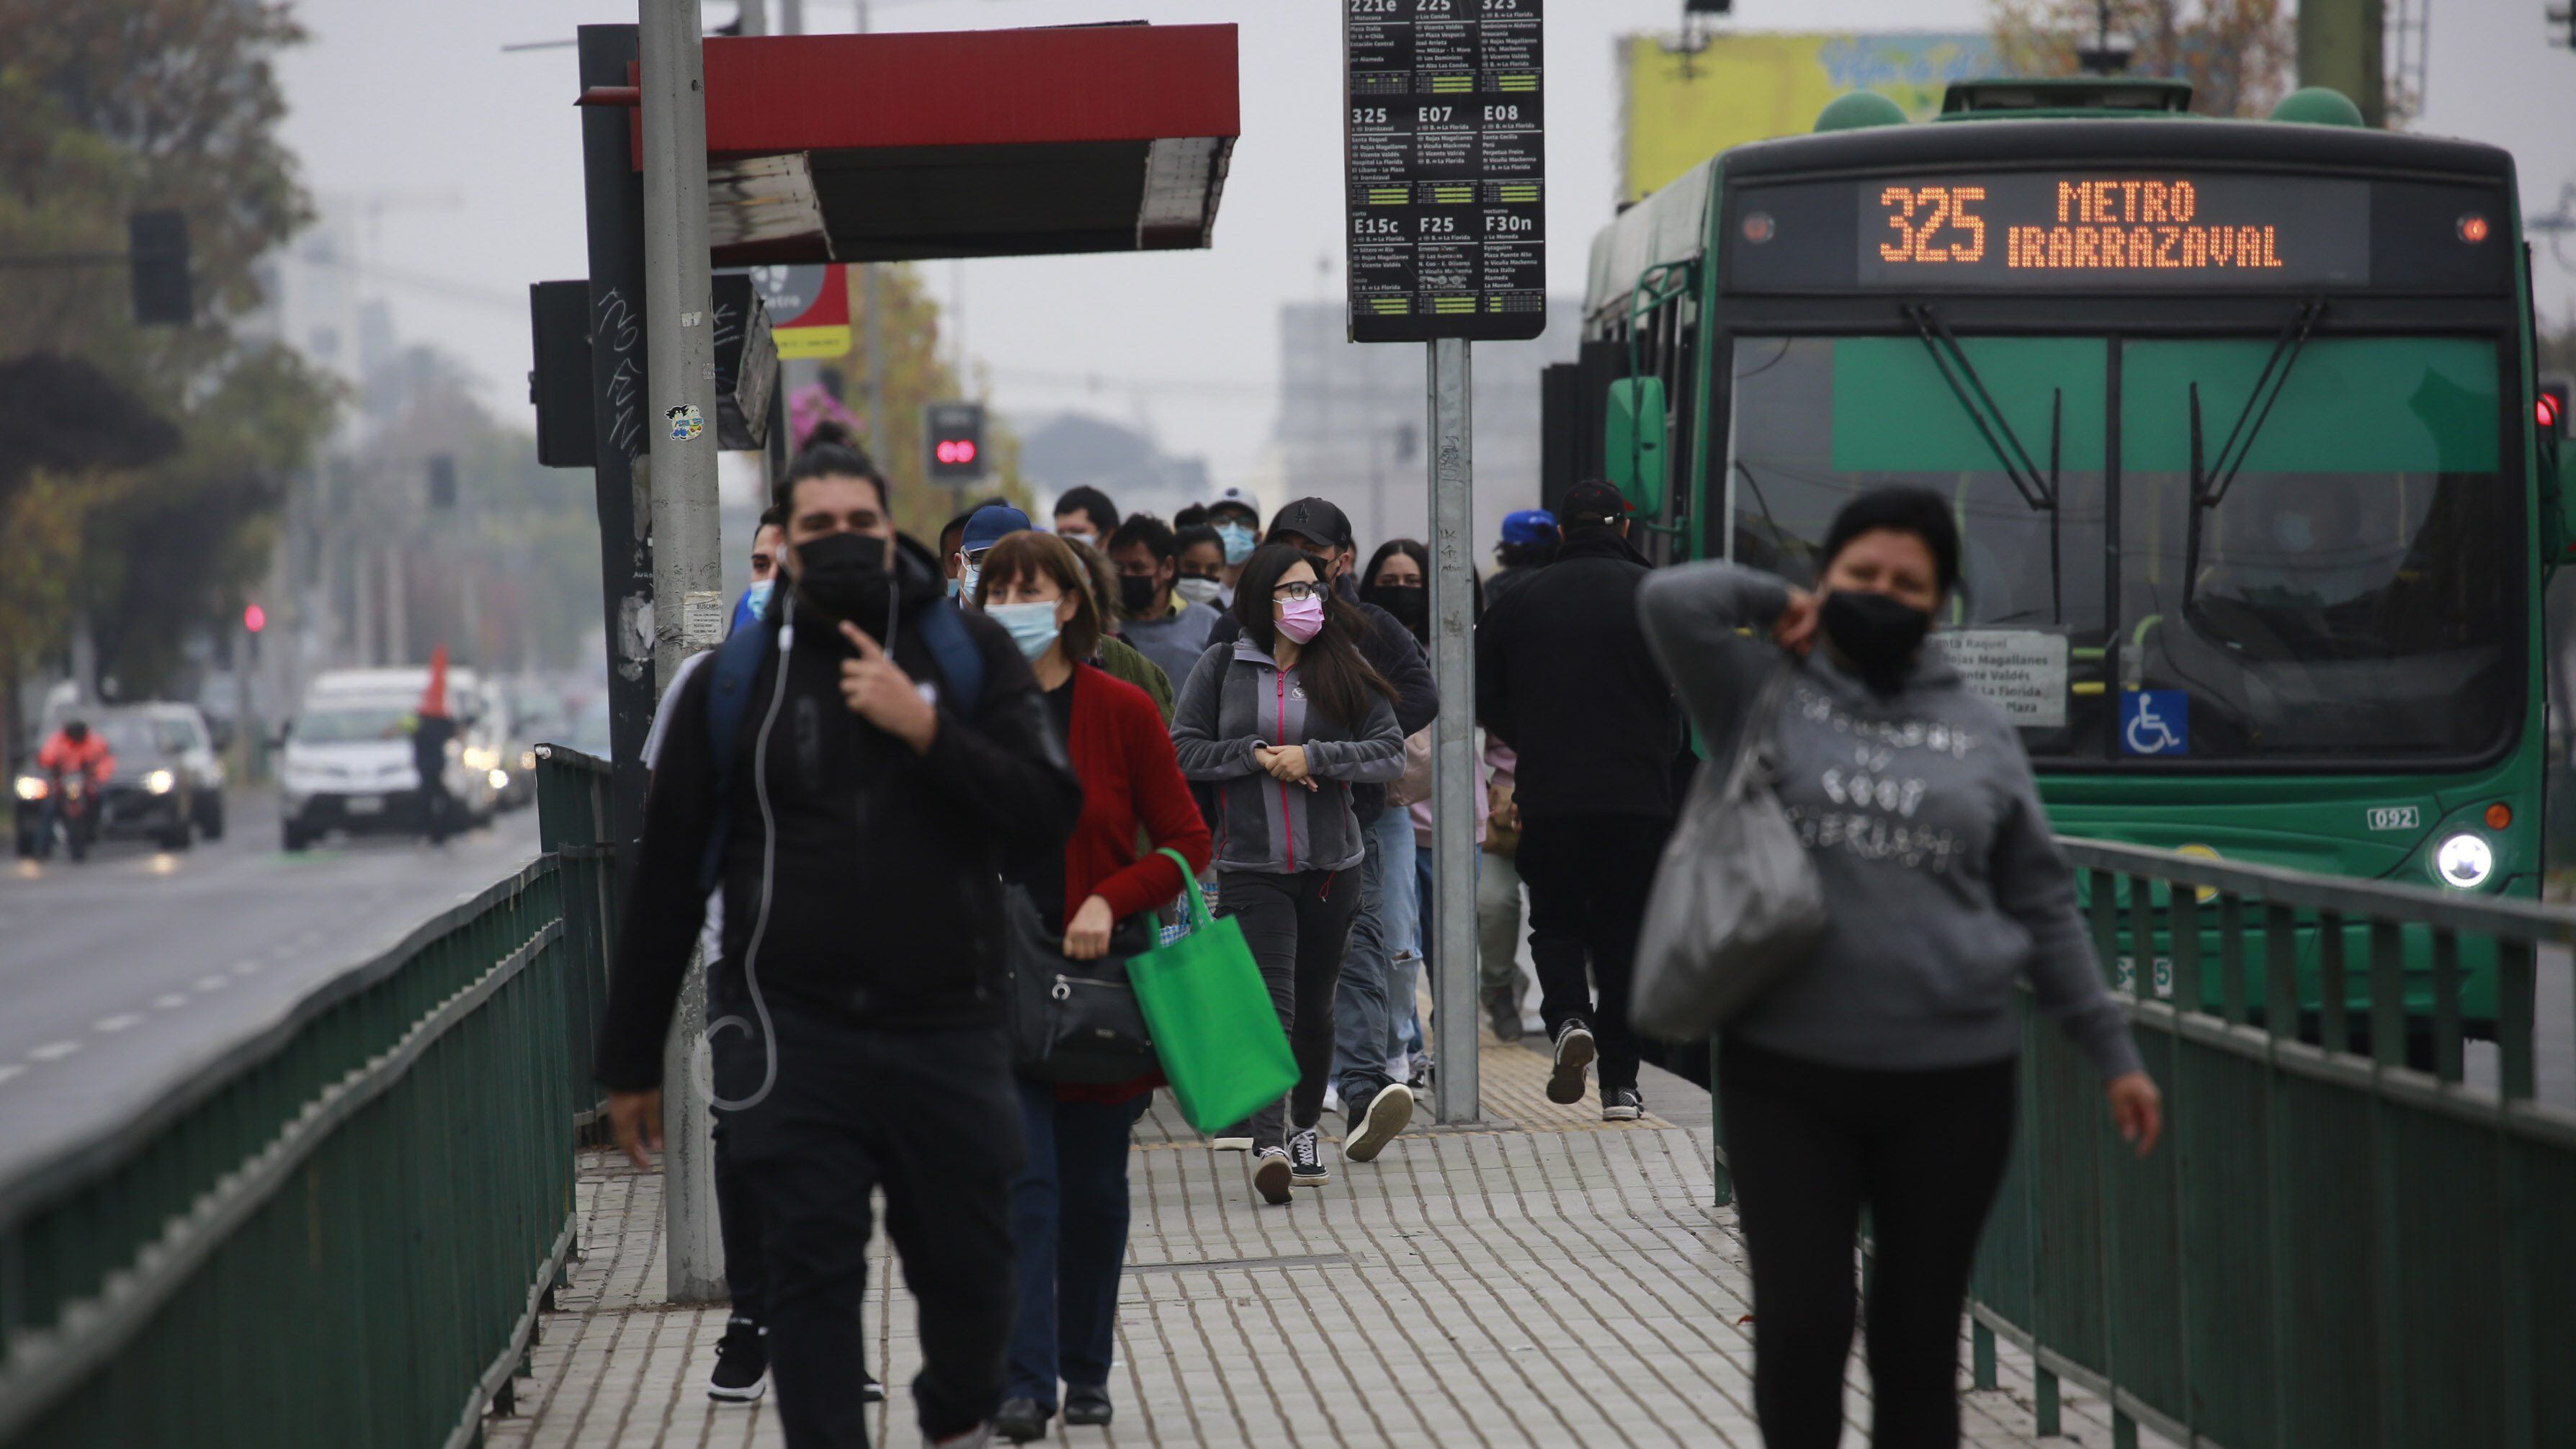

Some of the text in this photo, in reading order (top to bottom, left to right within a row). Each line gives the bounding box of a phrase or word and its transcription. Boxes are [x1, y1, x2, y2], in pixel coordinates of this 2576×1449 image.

[1351, 0, 1397, 12] 221e
[1416, 0, 1450, 11] 225
[1353, 108, 1386, 123] 325
[1419, 107, 1452, 122] E07
[1485, 106, 1518, 120] E08
[2059, 181, 2196, 222] METRO
[1355, 219, 1397, 233] E15c
[1420, 217, 1453, 232] F25
[1486, 216, 1531, 230] F30n
[1880, 187, 1985, 261] 325
[2008, 225, 2282, 267] IRARRAZAVAL
[1966, 638, 2007, 650] Raquel
[1979, 653, 2048, 667] Magallanes
[1990, 670, 2030, 681] Valdés
[1982, 686, 1994, 696] La
[1999, 685, 2041, 697] Florida
[2376, 810, 2412, 827] 092
